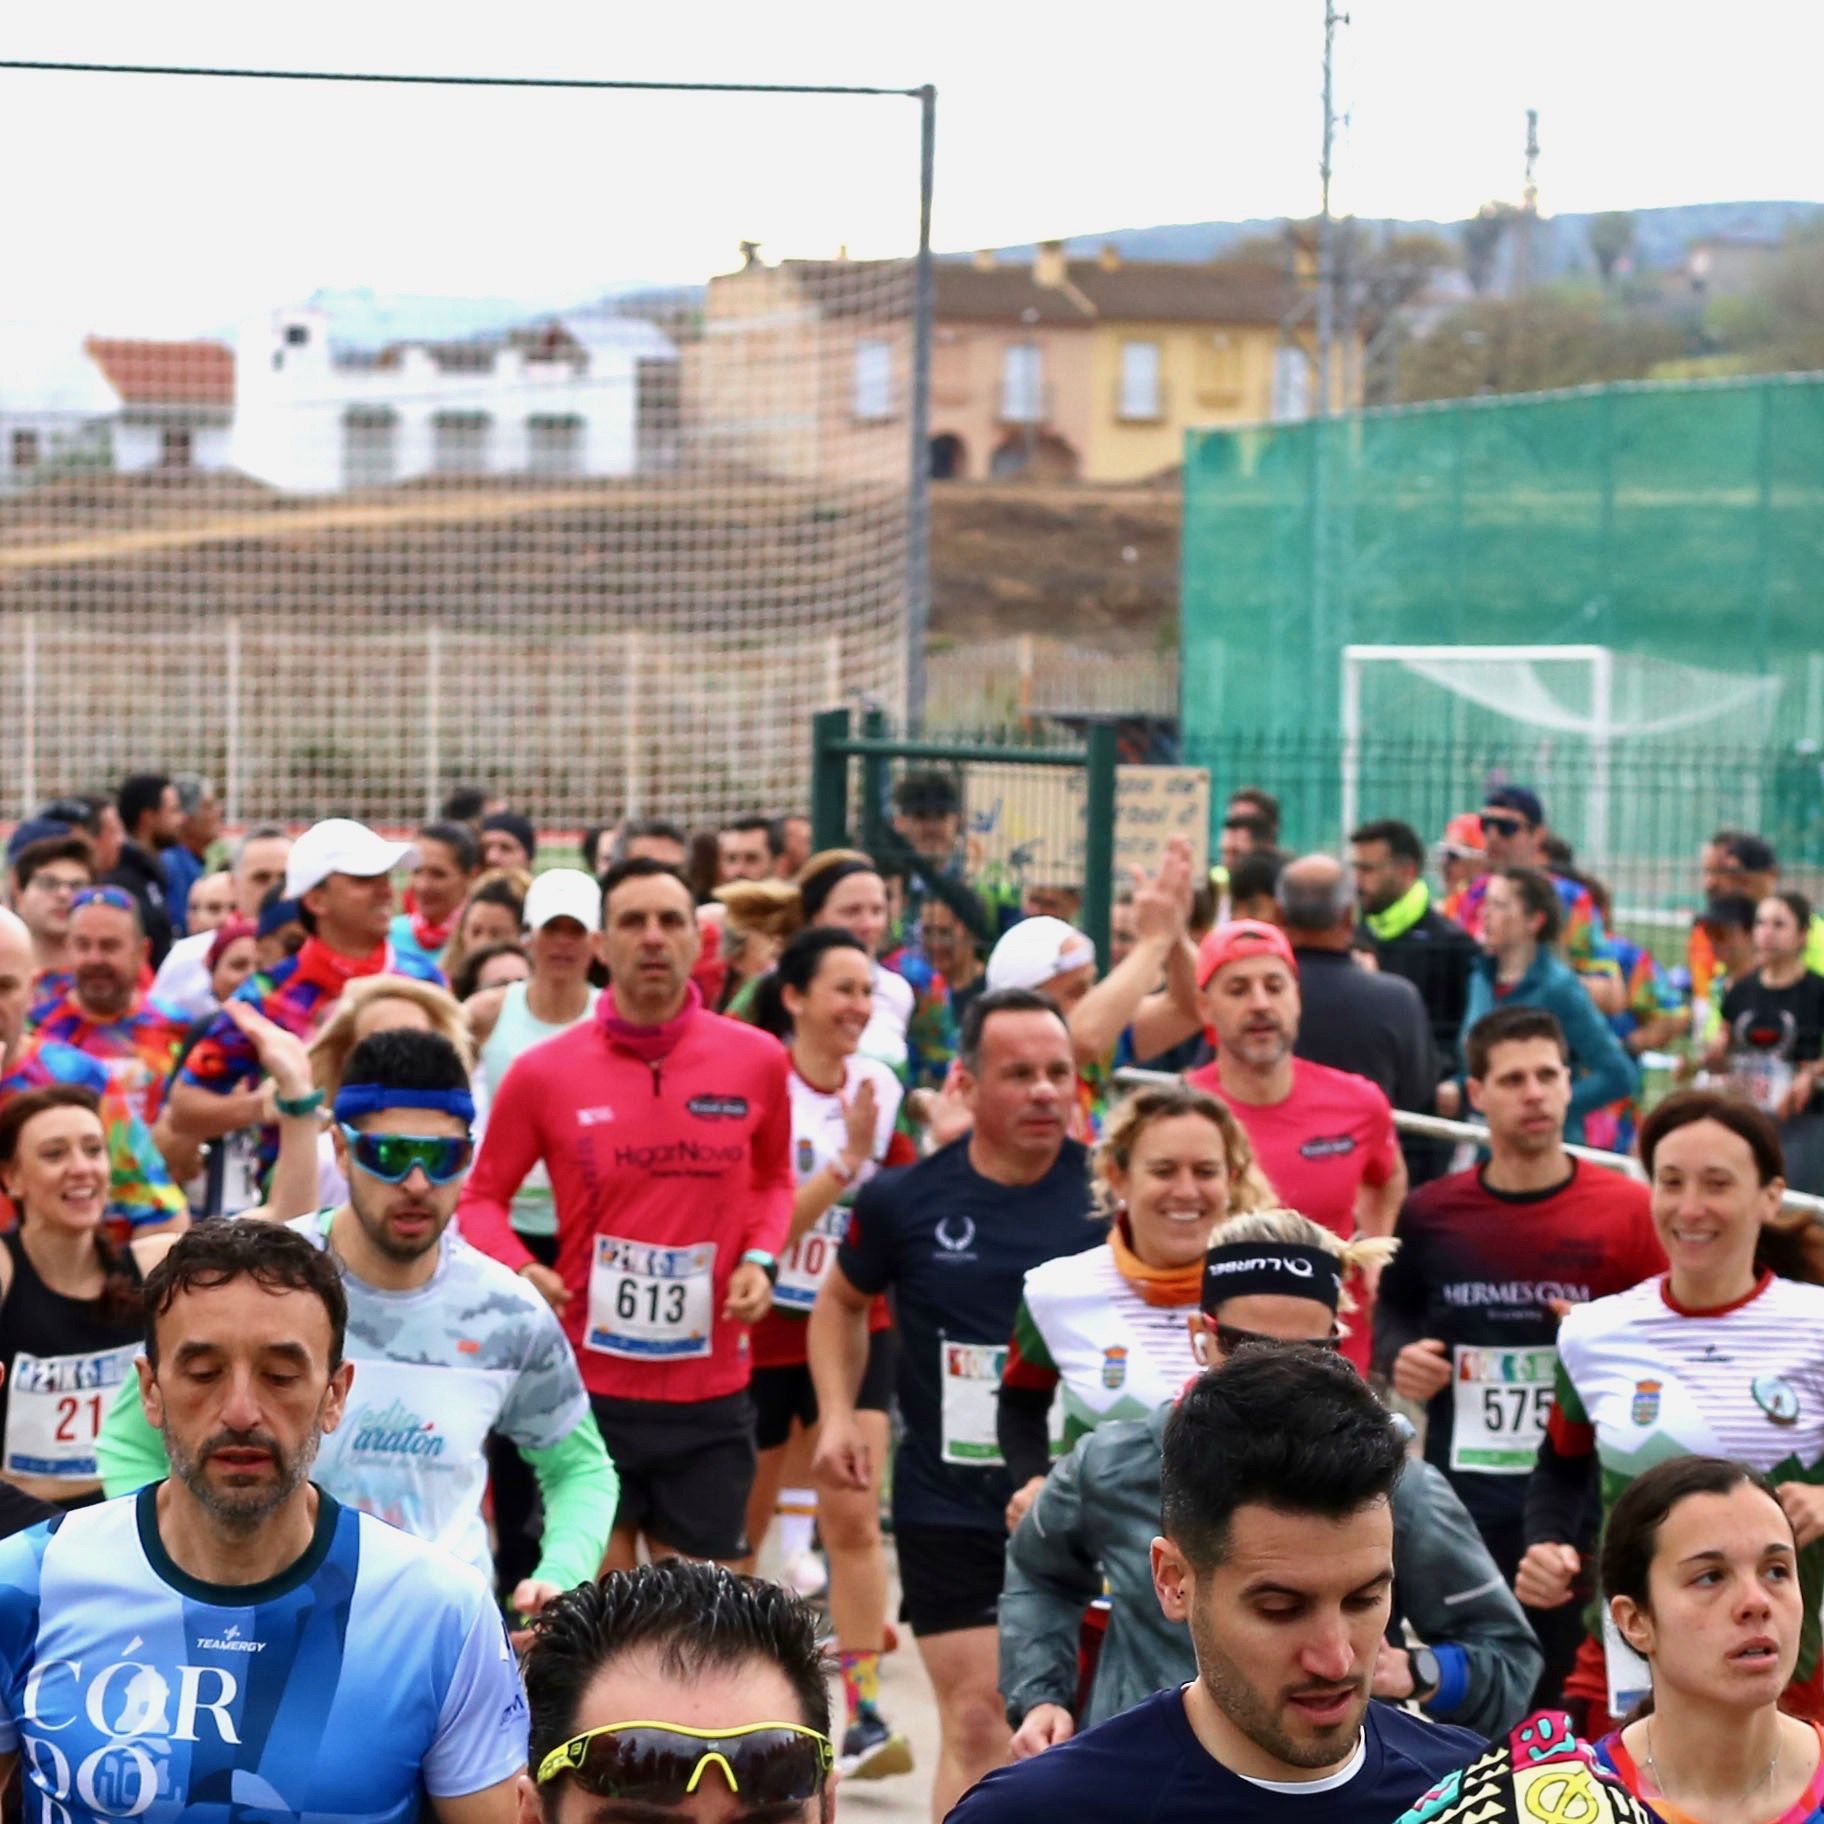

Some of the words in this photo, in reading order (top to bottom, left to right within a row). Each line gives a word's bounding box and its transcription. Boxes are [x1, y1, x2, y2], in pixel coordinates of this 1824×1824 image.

[617, 1279, 687, 1324] 613
[1443, 1282, 1534, 1307] HERMES
[1485, 1388, 1555, 1432] 575
[196, 1636, 268, 1654] TEAMERGY
